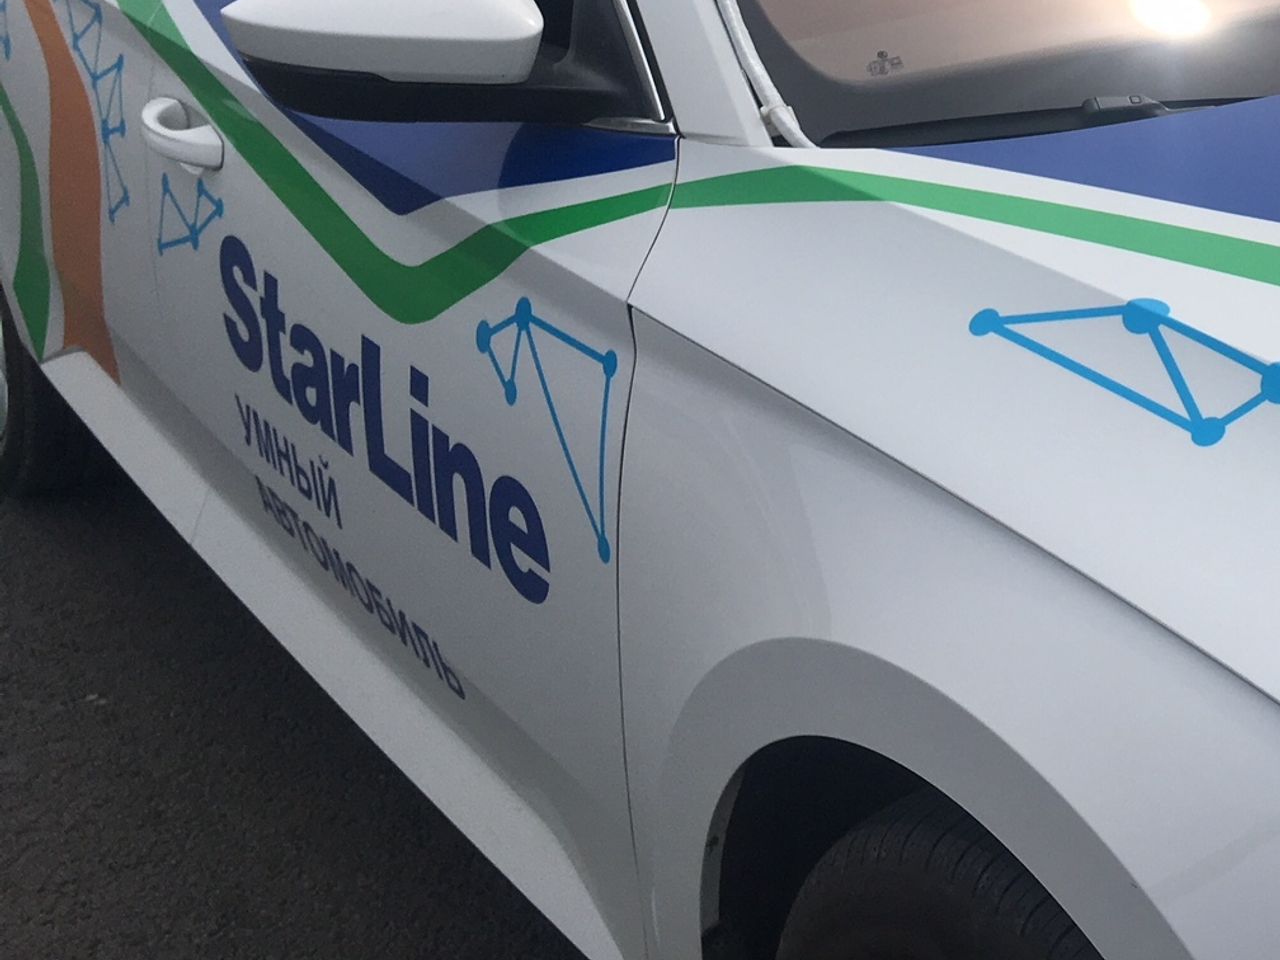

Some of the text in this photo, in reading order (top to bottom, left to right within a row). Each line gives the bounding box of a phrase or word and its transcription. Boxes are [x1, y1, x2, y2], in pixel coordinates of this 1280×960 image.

[219, 235, 551, 605] StarLine
[234, 393, 342, 529] УМНЫЙ
[255, 474, 466, 701] АВТОМОБИЛЬ
